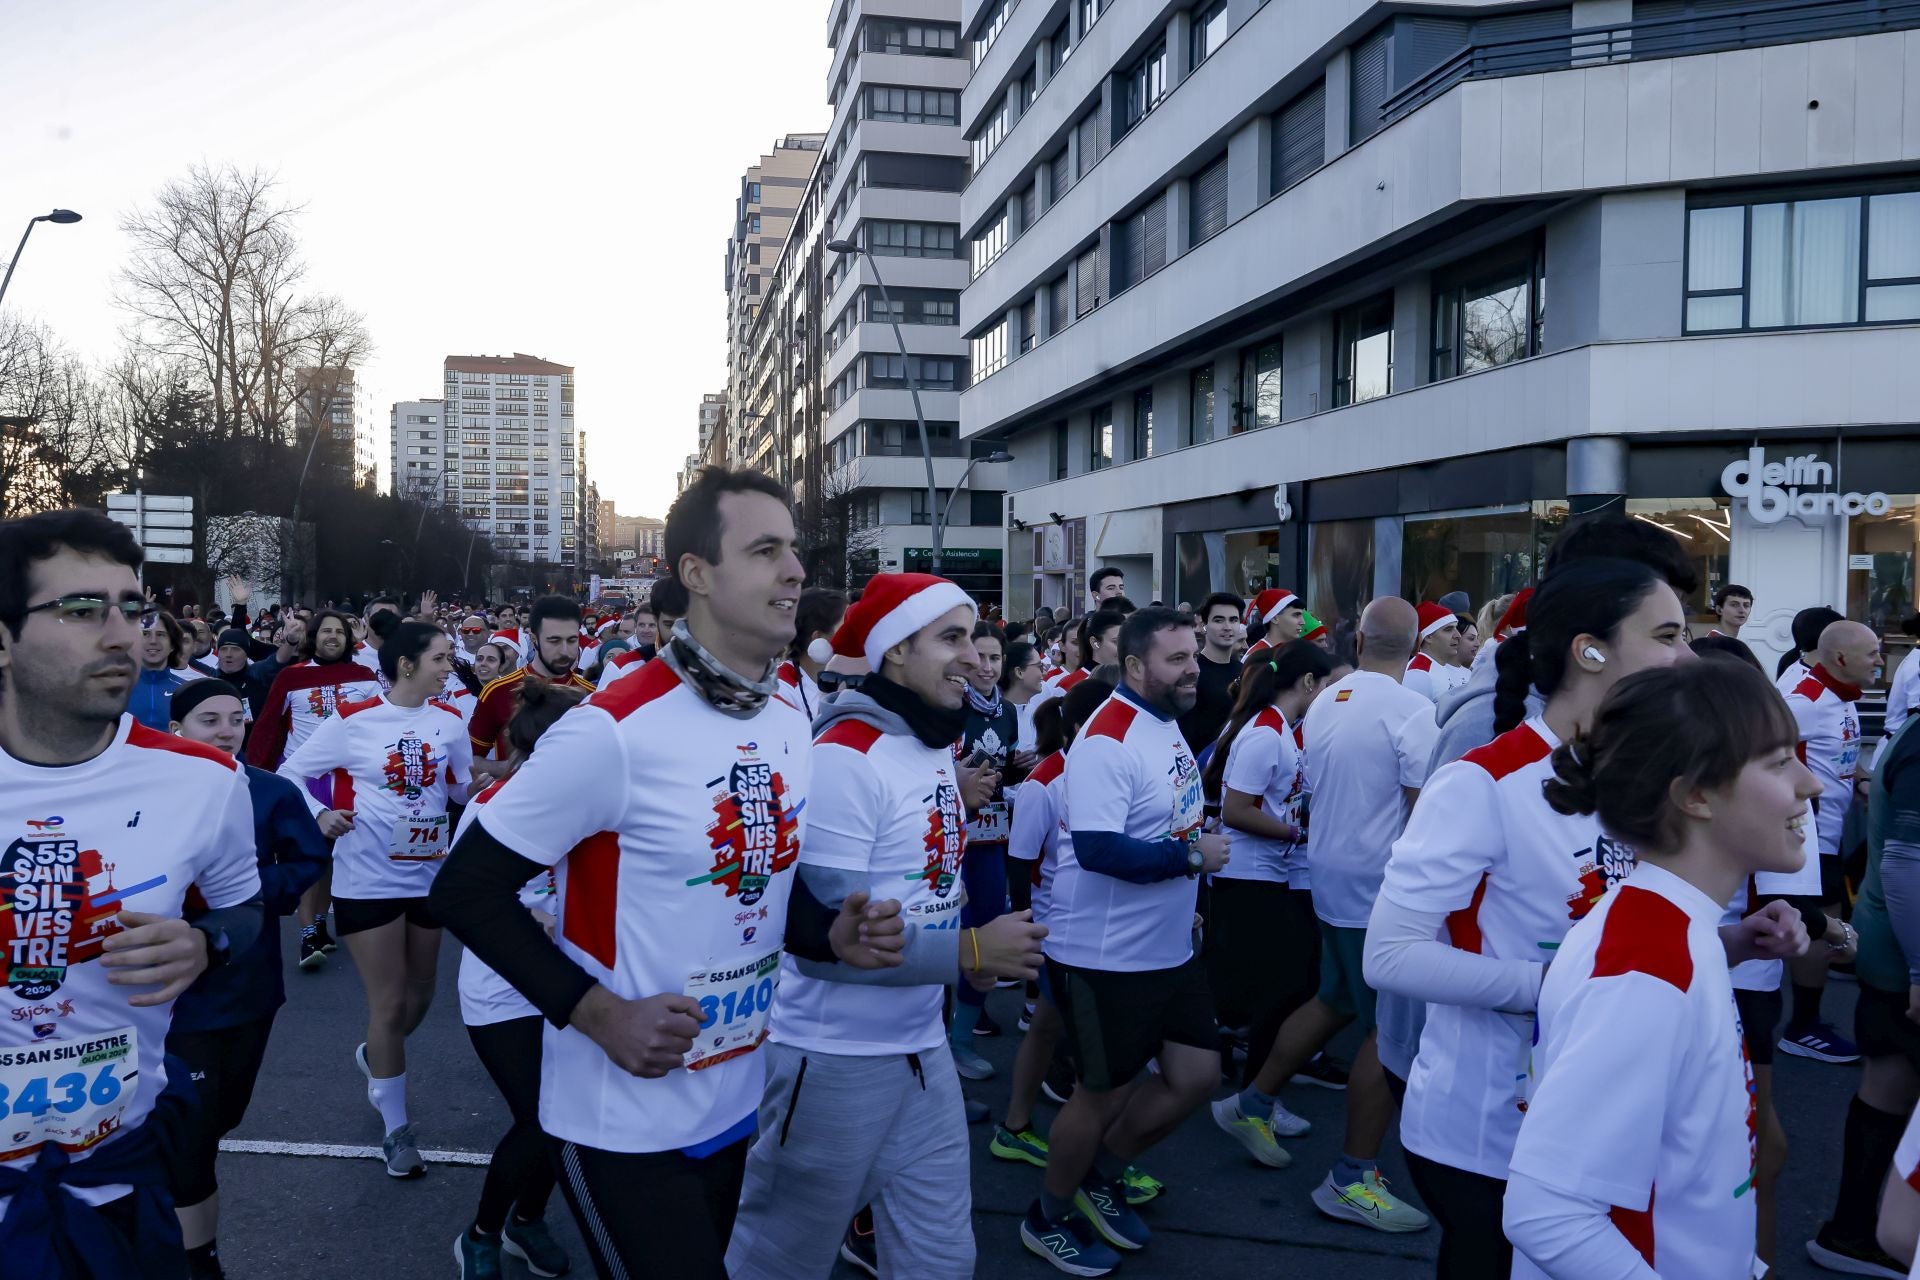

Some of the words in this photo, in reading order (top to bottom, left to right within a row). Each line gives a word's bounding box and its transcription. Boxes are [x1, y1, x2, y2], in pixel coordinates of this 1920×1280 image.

[1721, 447, 1832, 498] delfín
[1748, 484, 1892, 524] blanco
[922, 549, 944, 557] Ceo
[402, 746, 422, 755] SAN
[403, 755, 422, 765] SIL
[405, 766, 423, 776] VES
[748, 765, 770, 785] 55
[737, 779, 773, 803] SAN
[741, 801, 774, 826] SIL
[940, 797, 958, 814] SAN
[942, 815, 959, 834] SIL
[977, 814, 998, 829] 791
[408, 826, 438, 843] 714
[743, 824, 776, 849] VES
[944, 834, 960, 853] VES
[36, 843, 77, 864] 55
[741, 847, 775, 875] TRE
[1613, 842, 1634, 861] 55
[14, 858, 73, 884] SAN
[1603, 853, 1634, 878] SAN
[14, 884, 71, 911] SIL
[935, 902, 950, 913] SAN
[14, 910, 72, 937] VES
[8, 936, 69, 967] TRE
[710, 972, 724, 983] 55
[725, 968, 744, 981] SAN
[745, 951, 780, 974] SILVESTRE
[25, 985, 52, 996] 2024
[699, 977, 772, 1030] 3140
[16, 1050, 50, 1064] SAN
[53, 1034, 128, 1060] SILVESTRE
